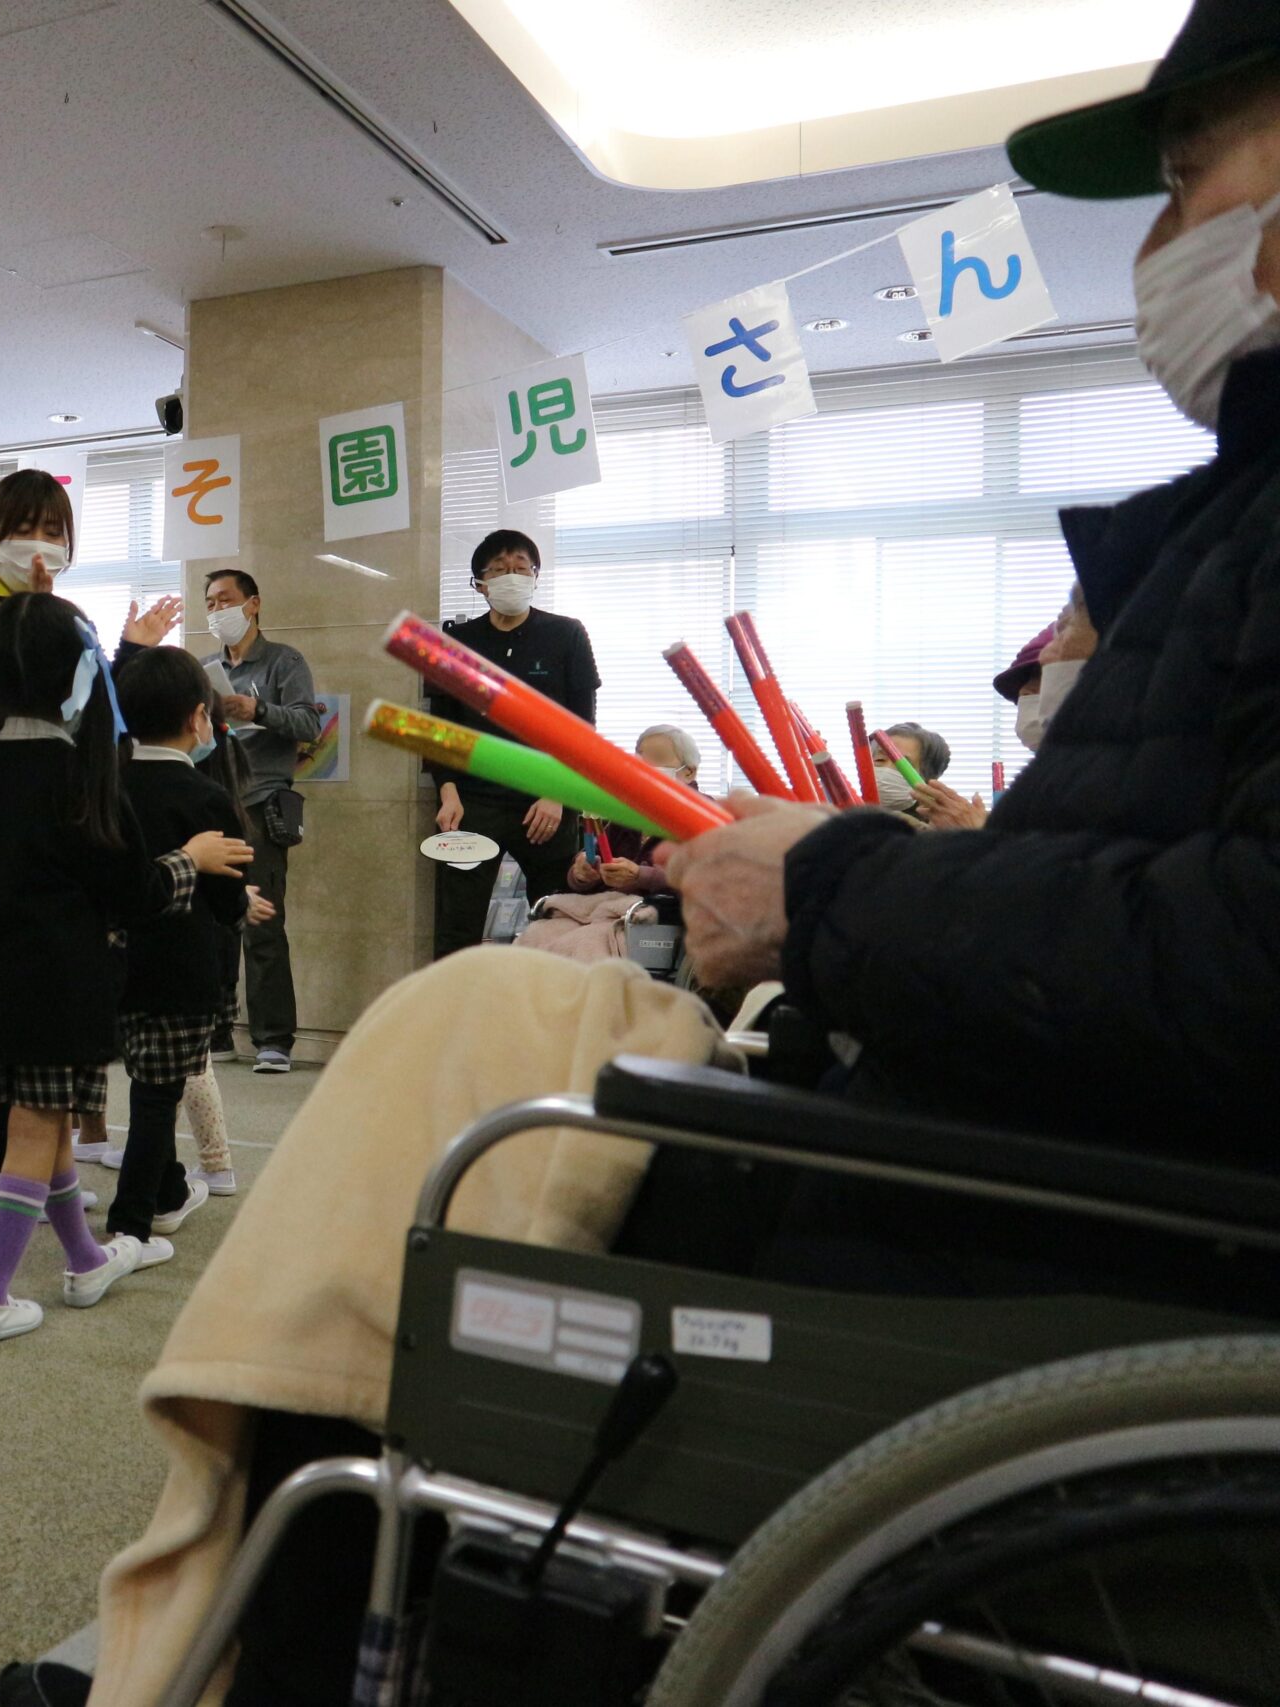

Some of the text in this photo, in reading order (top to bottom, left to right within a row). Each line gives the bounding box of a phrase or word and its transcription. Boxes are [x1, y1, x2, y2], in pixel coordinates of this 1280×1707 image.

[172, 459, 232, 526] そ
[330, 425, 398, 506] 園
[508, 378, 587, 468] 児
[704, 316, 786, 398] さ
[938, 230, 1022, 318] ん
